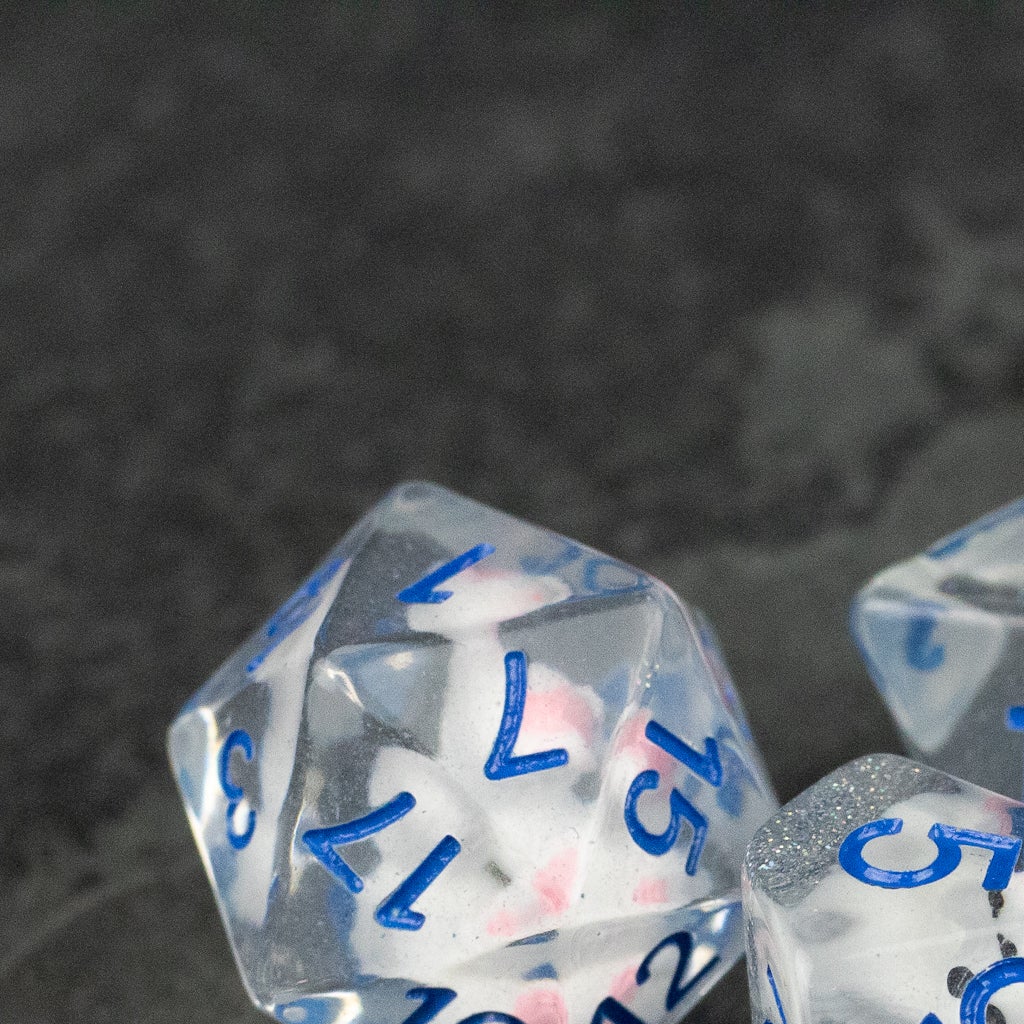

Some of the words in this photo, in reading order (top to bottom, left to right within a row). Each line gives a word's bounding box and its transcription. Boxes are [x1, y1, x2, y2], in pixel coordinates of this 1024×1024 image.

[397, 542, 496, 604] 1
[484, 651, 568, 781] 7
[302, 791, 461, 931] 17
[624, 719, 723, 876] 15
[838, 817, 1022, 890] 5
